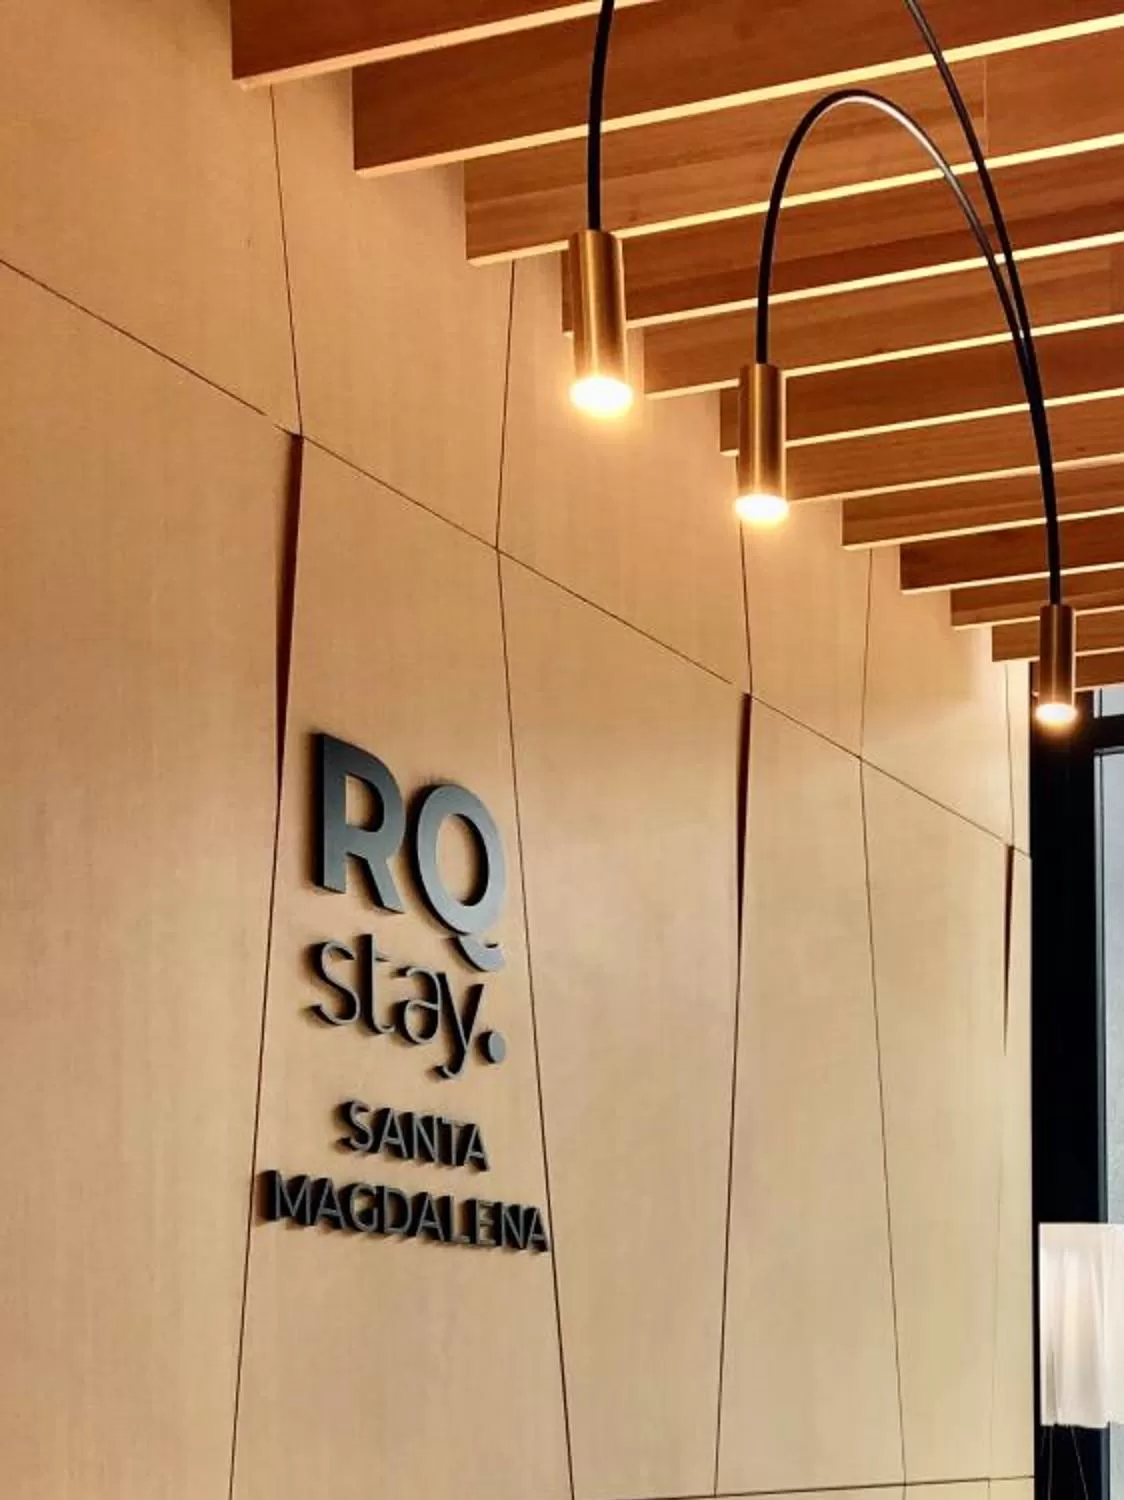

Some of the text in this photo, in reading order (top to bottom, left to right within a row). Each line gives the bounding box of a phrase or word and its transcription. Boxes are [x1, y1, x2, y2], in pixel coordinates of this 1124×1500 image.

[315, 732, 505, 972] RQ
[336, 1100, 490, 1172] SANTA
[262, 1170, 551, 1253] MAGDALENA
